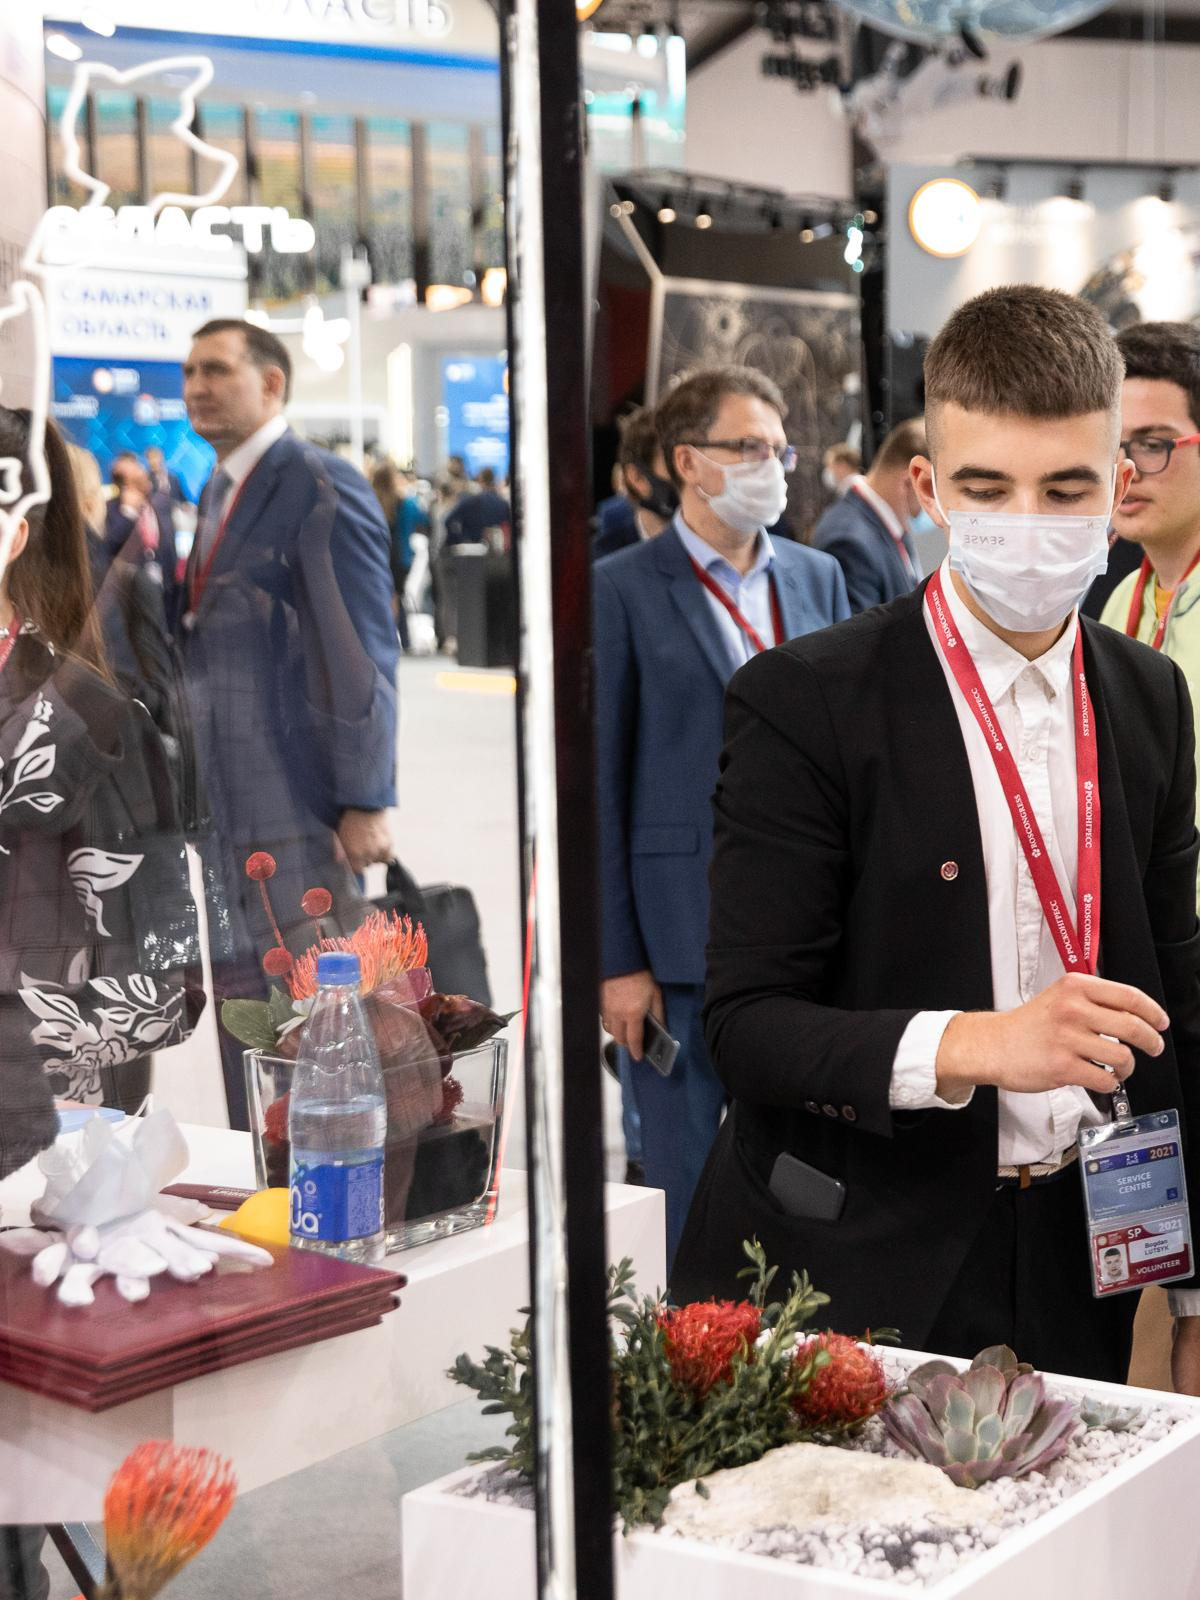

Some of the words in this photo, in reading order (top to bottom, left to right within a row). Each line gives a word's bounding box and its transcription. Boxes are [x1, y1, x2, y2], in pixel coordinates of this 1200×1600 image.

[932, 590, 952, 639] ROSCONGRESS
[971, 687, 1000, 744] РОСКОНГРЕСС
[1079, 681, 1090, 737] ROSCONGRESS
[1014, 794, 1038, 850] ROSCONGRESS
[1084, 789, 1094, 849] РОСКОНГРЕСС
[1049, 900, 1075, 955] РОСКОНГРЕСС
[1083, 902, 1094, 960] ROSCONGRESS
[1150, 1145, 1174, 1159] 2021
[1117, 1171, 1152, 1186] SERVICE
[1119, 1181, 1152, 1194] CENTRE
[1127, 1227, 1142, 1239] SP
[1158, 1219, 1183, 1232] 2021
[1145, 1239, 1168, 1250] Bogdan
[1136, 1259, 1181, 1275] VOLUNTEER
